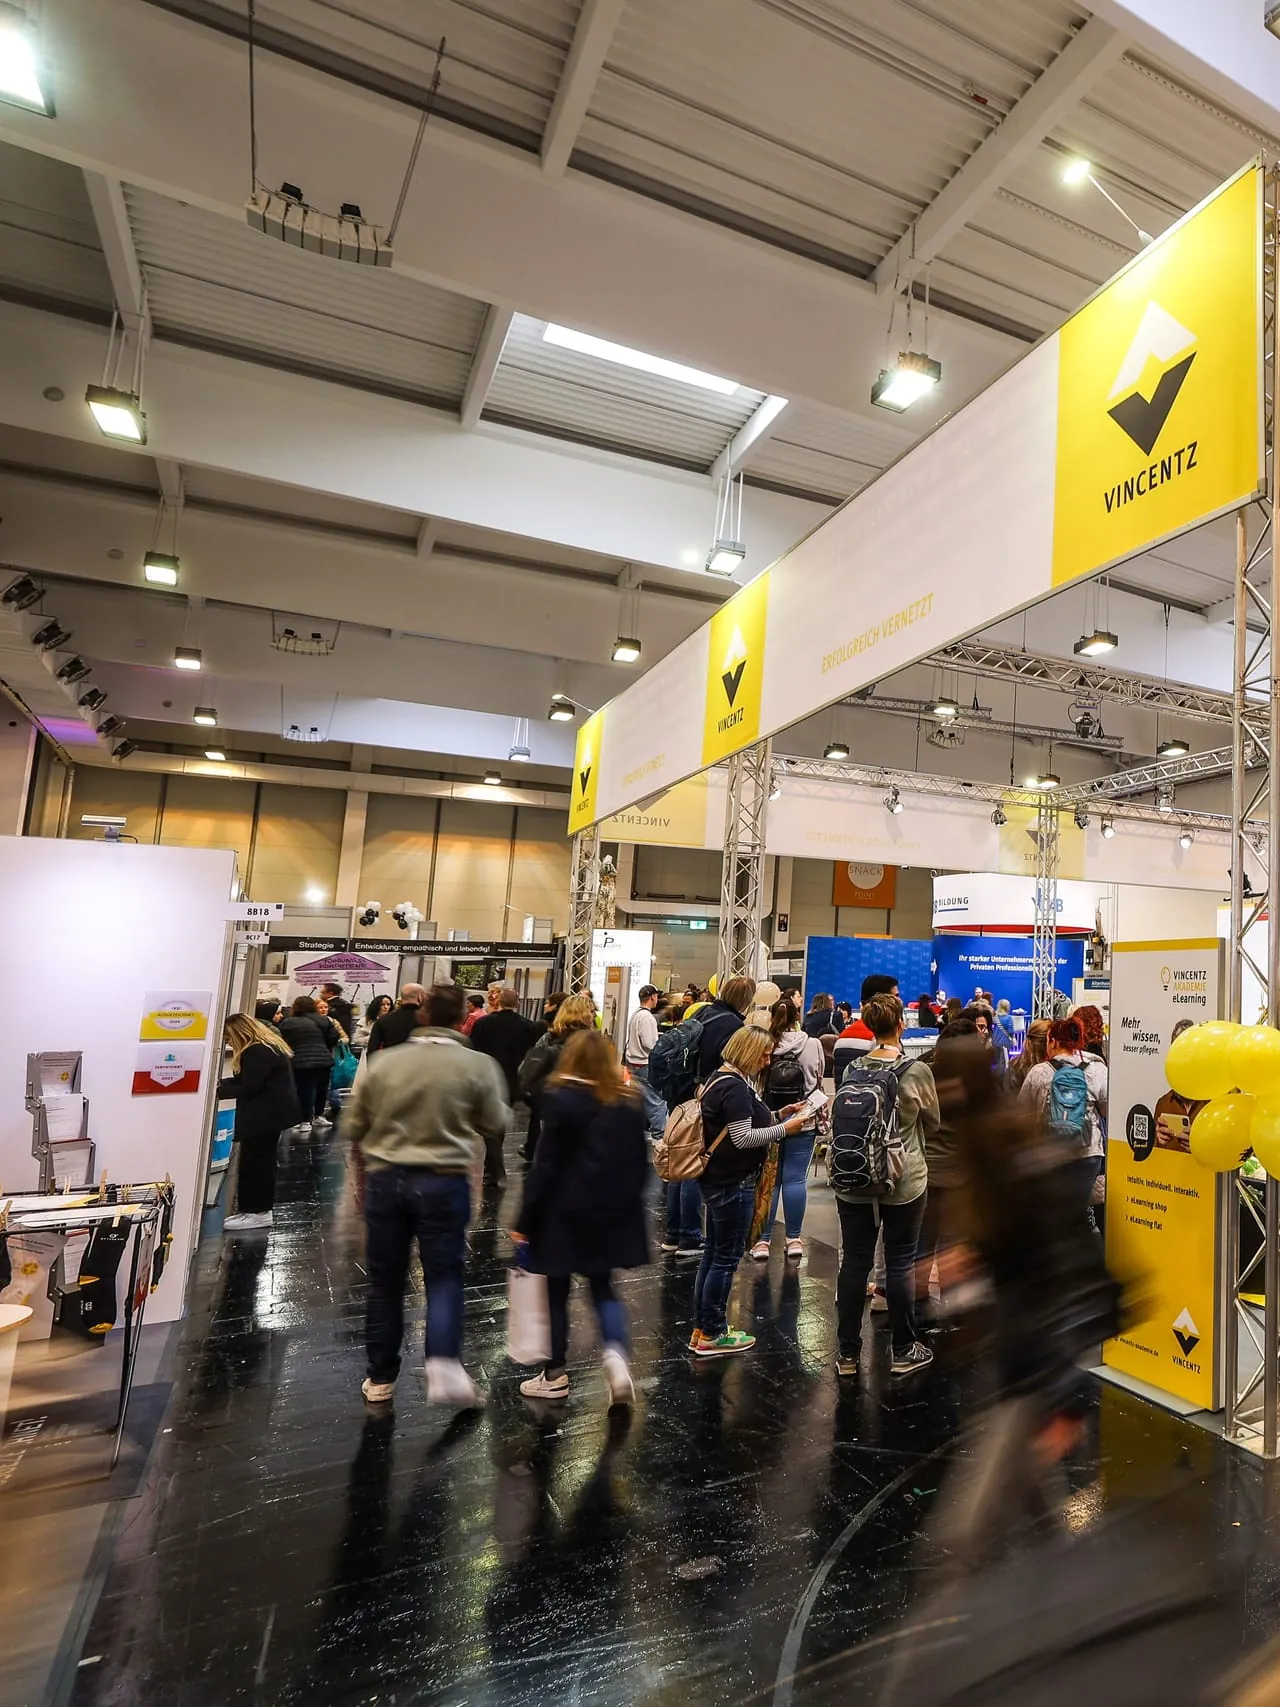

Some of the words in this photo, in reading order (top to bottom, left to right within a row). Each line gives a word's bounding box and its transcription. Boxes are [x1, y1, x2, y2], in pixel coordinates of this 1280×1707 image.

[1104, 441, 1198, 513] VINCENTZ
[821, 625, 879, 674] ERFOLGREICH
[881, 593, 934, 638] VERNETZT
[718, 708, 744, 734] VINCENTZ
[849, 866, 883, 876] SNACK
[938, 896, 969, 906] BILDUNG
[246, 907, 270, 916] 8B18
[355, 943, 401, 951] Entwicklung:
[1058, 957, 1068, 965] der
[970, 963, 994, 971] Privaten
[1173, 971, 1206, 980] VINCENTZ
[1174, 982, 1206, 991] AKADEMIE
[1173, 993, 1206, 1006] eLearning
[1121, 1017, 1141, 1028] Mehr
[1132, 1030, 1160, 1044] wissen,
[1123, 1044, 1139, 1052] besser
[1139, 1045, 1160, 1055] pflegen.
[1131, 1196, 1154, 1209] eLearning
[1155, 1201, 1168, 1213] shop
[1130, 1215, 1153, 1229] eLearning
[1172, 1355, 1201, 1375] VINCENTZ
